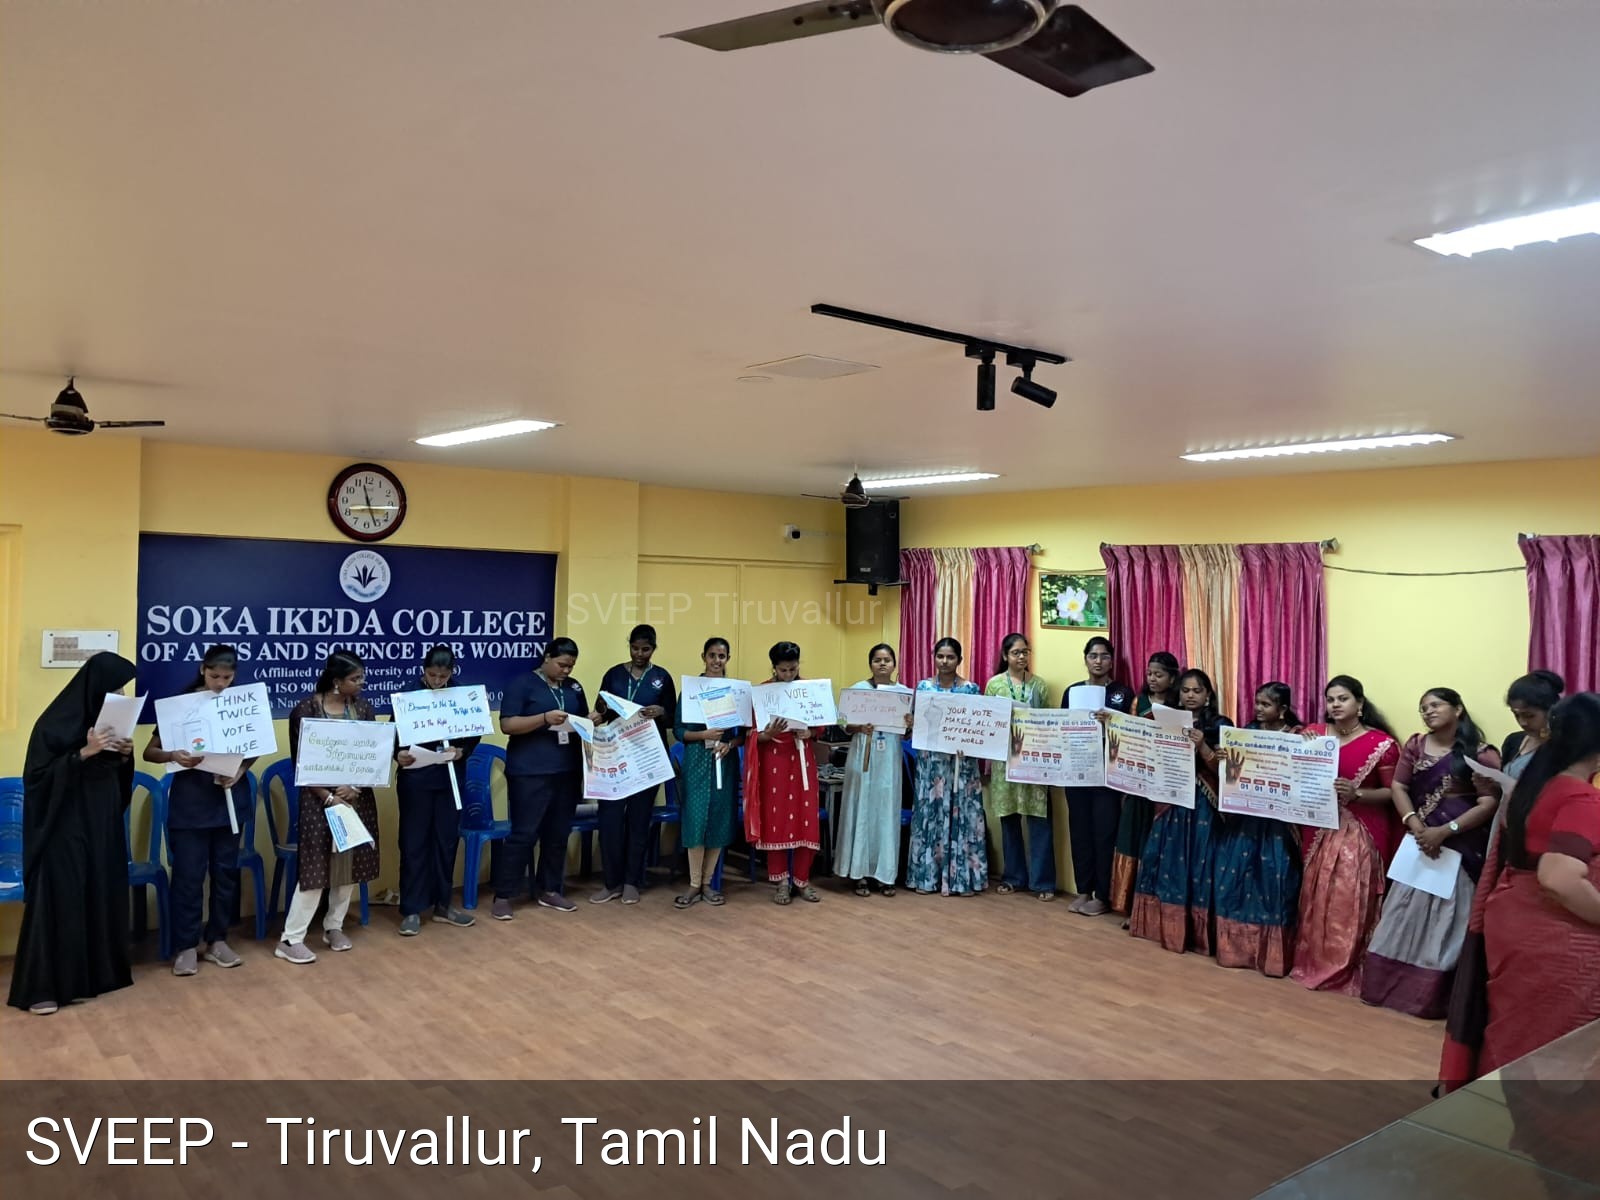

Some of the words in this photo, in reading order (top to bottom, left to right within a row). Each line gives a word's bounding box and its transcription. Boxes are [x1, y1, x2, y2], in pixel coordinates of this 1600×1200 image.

[147, 605, 259, 636] SOKA
[267, 607, 384, 636] IKEDA
[392, 609, 546, 636] COLLEGE
[141, 642, 178, 662] OF
[256, 642, 308, 661] AND
[420, 641, 464, 659] FR
[470, 641, 547, 658] WOMEN
[253, 667, 312, 680] (Affiliated
[406, 665, 417, 675] of
[275, 682, 298, 693] ISO
[785, 688, 808, 699] VOTE
[211, 691, 257, 708] THINK
[217, 705, 261, 720] TWICE
[947, 707, 967, 715] YOUR
[945, 717, 971, 725] MAKES
[976, 719, 991, 727] ALL
[222, 723, 255, 737] VOTE
[942, 726, 985, 736] DIFFERENCE
[227, 740, 259, 754] WISE
[961, 737, 984, 745] WORLD
